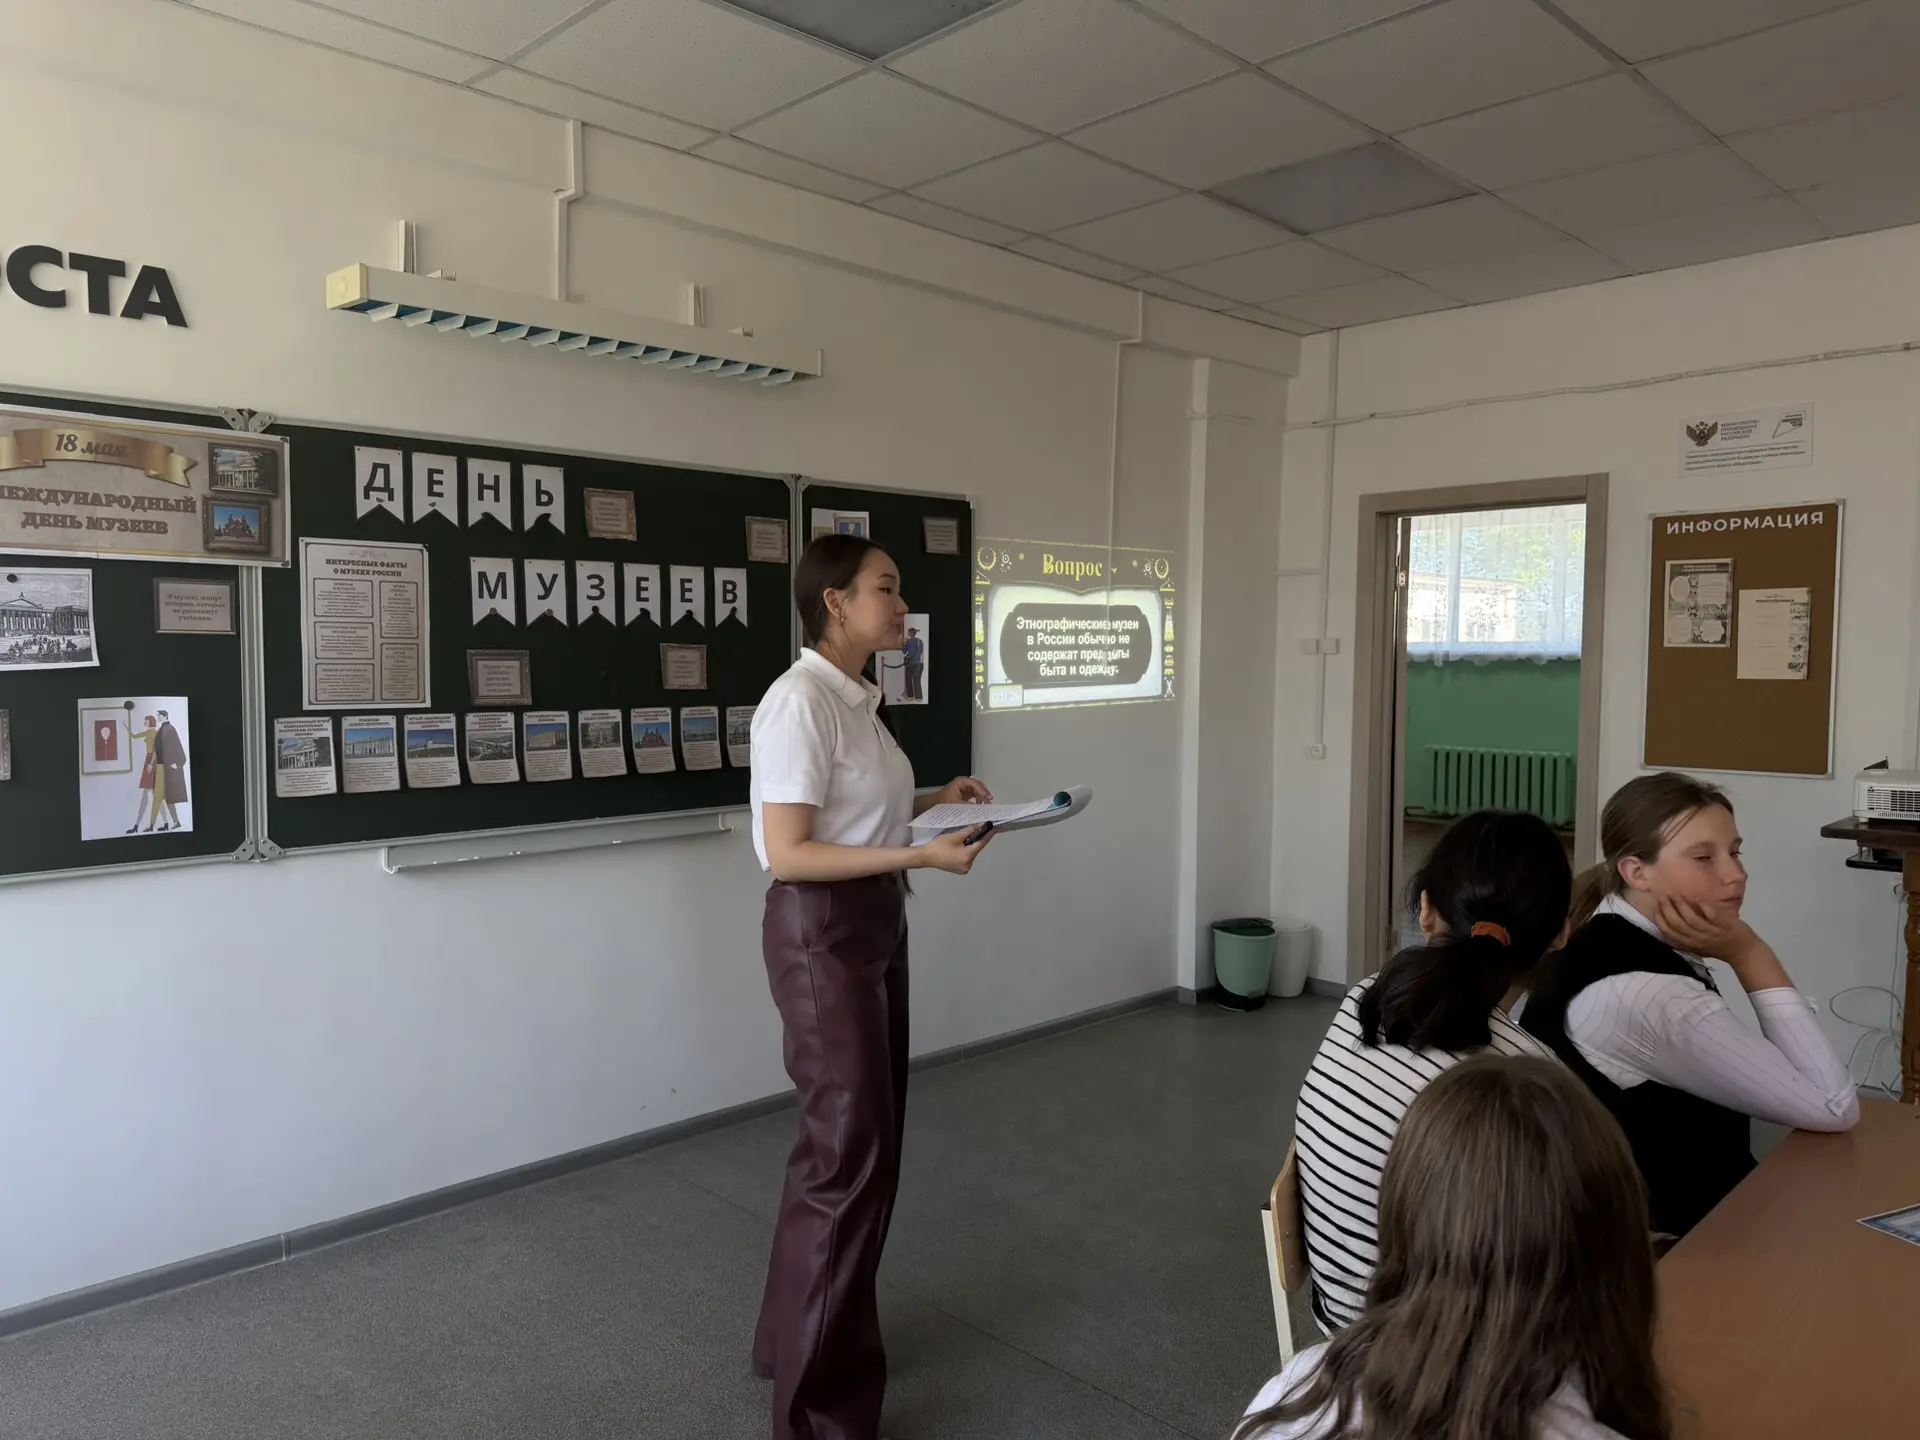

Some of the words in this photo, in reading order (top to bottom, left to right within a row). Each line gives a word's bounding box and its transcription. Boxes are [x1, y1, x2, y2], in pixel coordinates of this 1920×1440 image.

[0, 245, 189, 328] СТА
[56, 433, 78, 453] 18
[81, 440, 128, 457] мая
[21, 511, 82, 529] ДЕНЬ
[86, 515, 169, 534] МУЗЕЕВ
[1666, 511, 1824, 535] ИНФОРМАЦИЯ
[326, 558, 379, 568] ИНТЕРЕСНЫЕ
[379, 561, 408, 569] ФАКТЫ
[1043, 553, 1103, 582] Вопрос
[1112, 619, 1139, 632] музеи
[1027, 635, 1034, 645] в
[1037, 632, 1075, 646] России
[1119, 634, 1130, 644] не
[1027, 649, 1078, 663] содержат
[1040, 663, 1067, 676] быта
[1070, 665, 1076, 676] и
